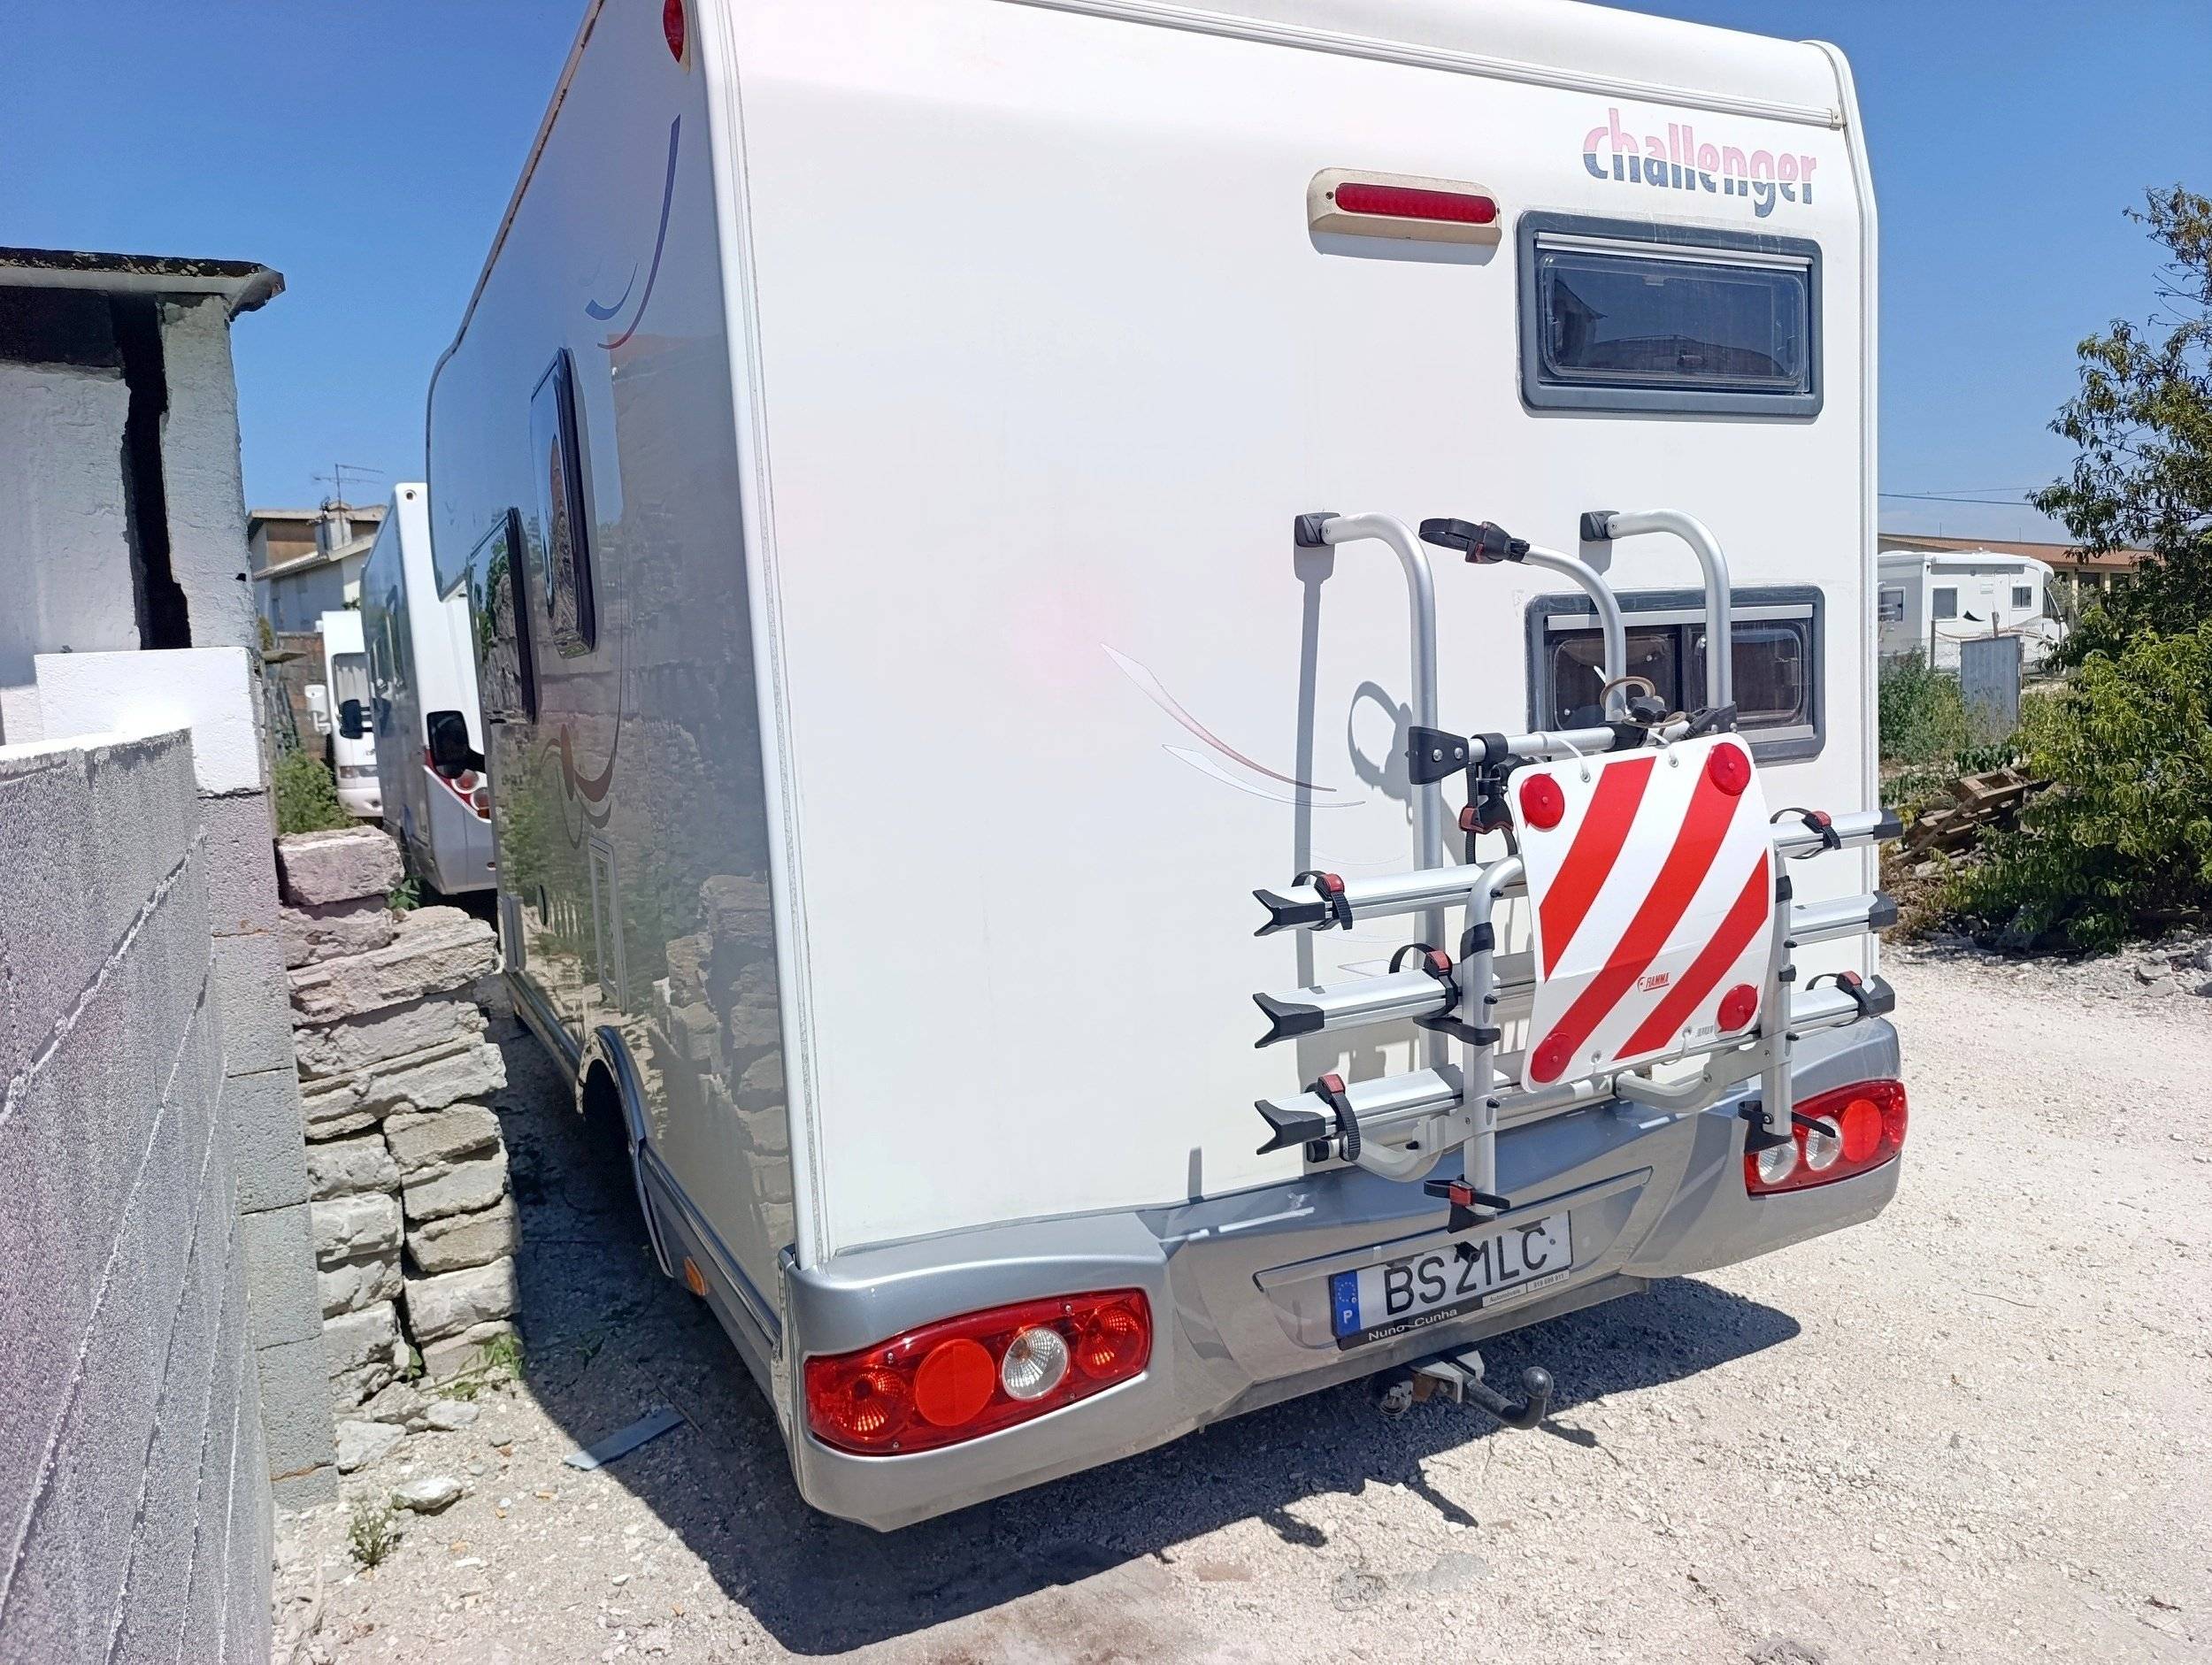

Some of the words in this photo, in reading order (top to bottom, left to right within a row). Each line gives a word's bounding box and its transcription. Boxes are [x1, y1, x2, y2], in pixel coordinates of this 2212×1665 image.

[1583, 107, 1816, 219] challenger
[1343, 1309, 1353, 1324] P
[1368, 1324, 1405, 1341] Nuno
[1414, 1308, 1457, 1327] Cunha
